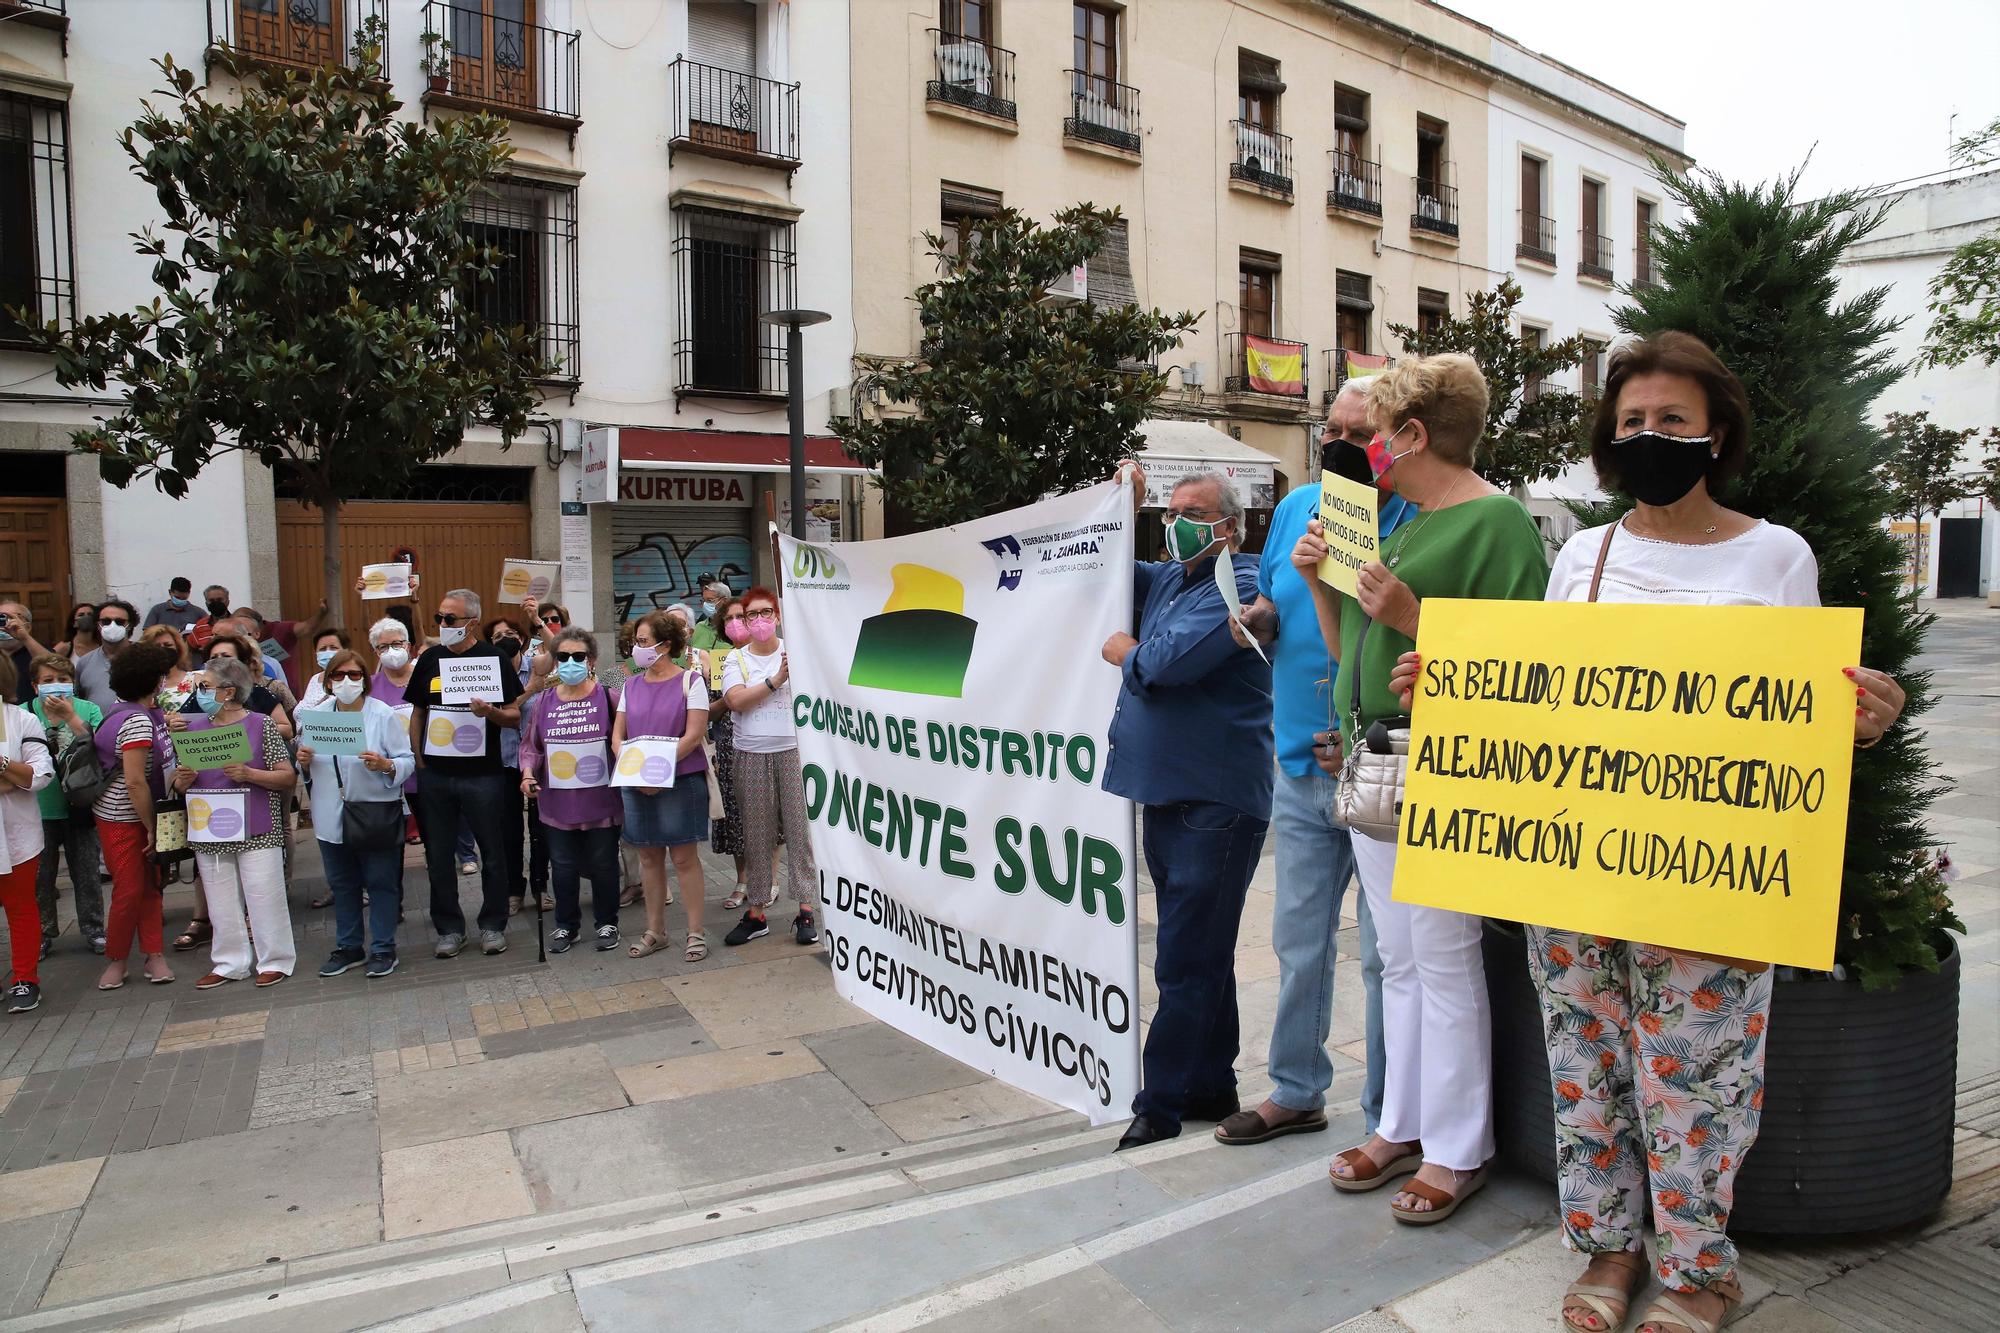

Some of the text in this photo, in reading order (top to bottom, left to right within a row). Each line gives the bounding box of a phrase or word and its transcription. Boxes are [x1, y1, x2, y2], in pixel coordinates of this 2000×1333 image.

[585, 460, 607, 474] KURTUBA
[618, 476, 745, 501] KURTUBA
[1323, 492, 1371, 524] NO NOS QUITEN
[1021, 532, 1054, 546] FEDERACIÓN
[1054, 533, 1061, 542] DE
[1348, 528, 1358, 545] DE
[1359, 533, 1375, 551] LOS
[1077, 562, 1098, 571] CIUDAD
[825, 582, 851, 591] ciudadano
[462, 664, 492, 672] CENTROS
[1424, 658, 1813, 724] SR. BELLIDO, USTED NO GANA
[588, 706, 598, 714] DE
[304, 724, 363, 733] CONTRATACIONES
[547, 723, 600, 737] YERBABUENA
[191, 736, 210, 744] NOS
[210, 731, 243, 741] QUITEN
[312, 735, 341, 743] MASIVAS
[793, 694, 1097, 785] CONSEJO DE DISTRITO
[185, 741, 241, 755] LOS CENTROS
[199, 753, 232, 763] CÍVICOS
[1415, 734, 1826, 813] ALEJANDO Y EMPOBRECIENDO
[1406, 803, 1792, 897] LA ATENCIÓN CIUDADANA
[994, 816, 1127, 926] SUR
[836, 875, 1130, 1034] DESMANTELAMIENTO
[856, 945, 977, 1034] CENTROS
[984, 1003, 1111, 1107] CÍVICOS
